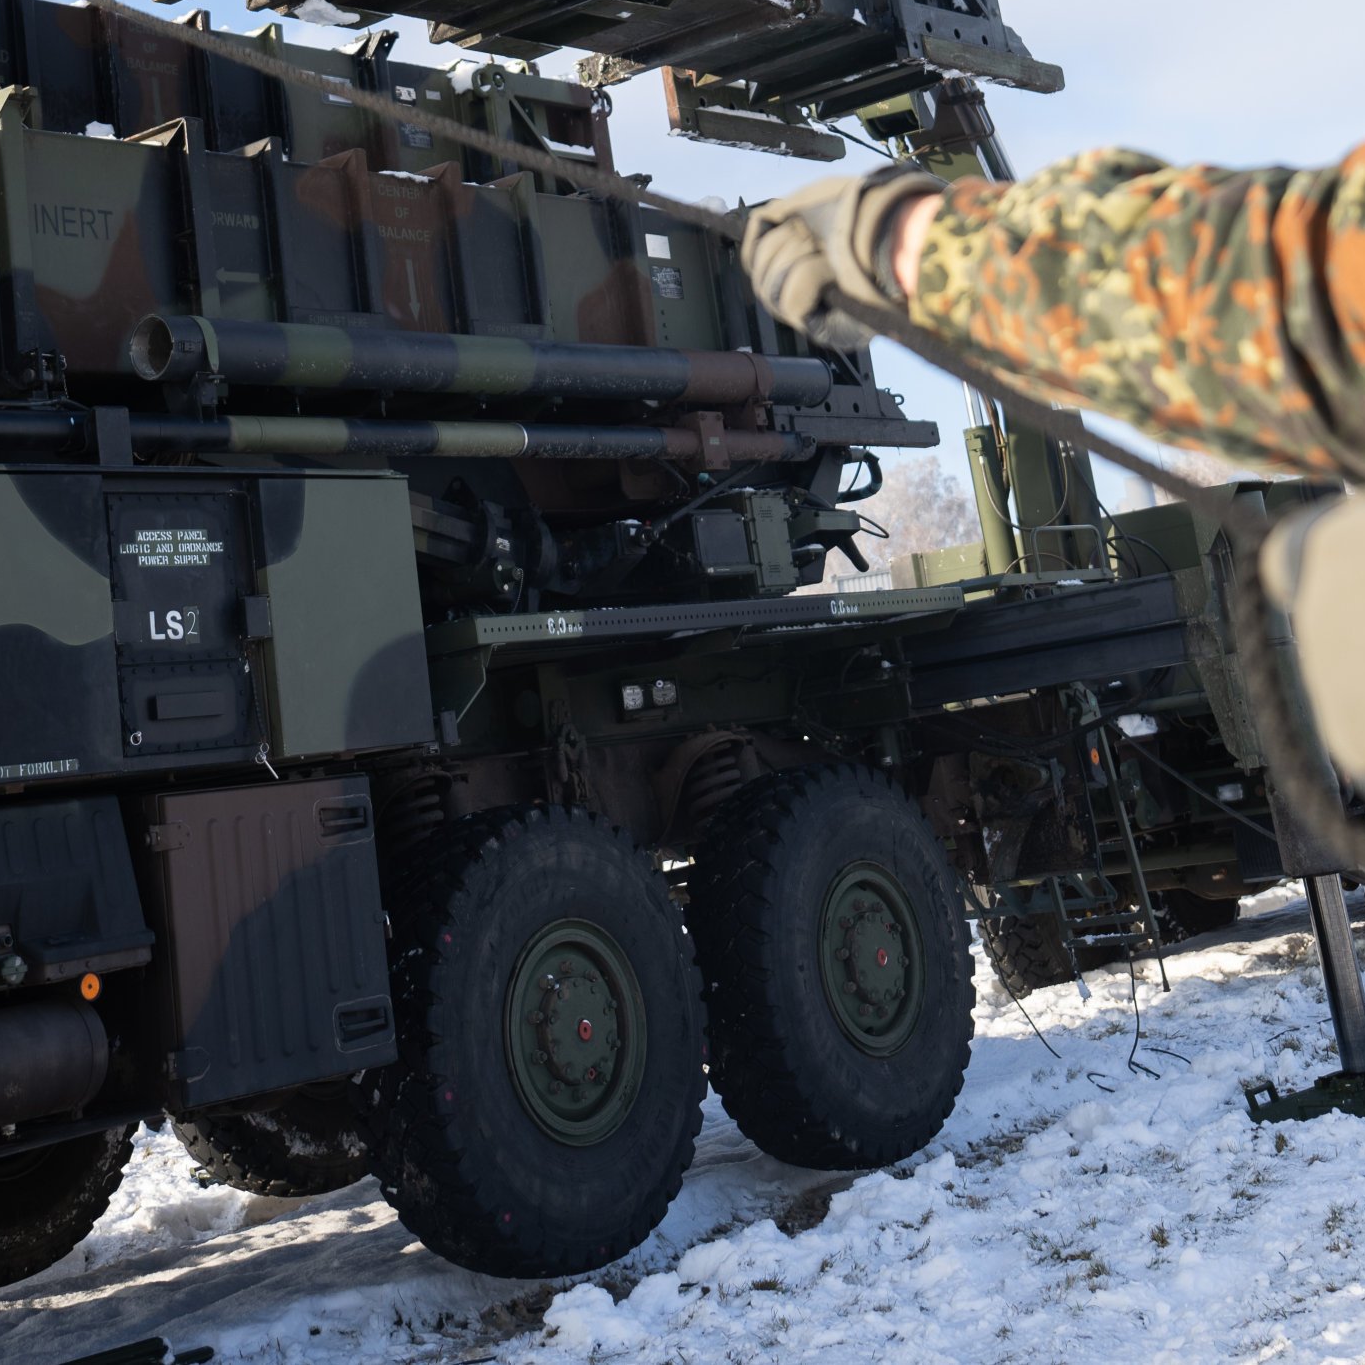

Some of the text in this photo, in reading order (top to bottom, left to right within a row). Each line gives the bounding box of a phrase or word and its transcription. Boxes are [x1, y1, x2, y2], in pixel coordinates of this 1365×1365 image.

[378, 183, 422, 200] CENTER
[395, 206, 410, 219] OF
[33, 203, 113, 240] INERT
[378, 224, 432, 243] BALANCE
[137, 530, 206, 541] ACCESS PANEL
[119, 542, 224, 554] LOGIC AND ORDNANCE
[138, 554, 208, 566] POWER SUPPLY
[547, 617, 566, 635] 6,0
